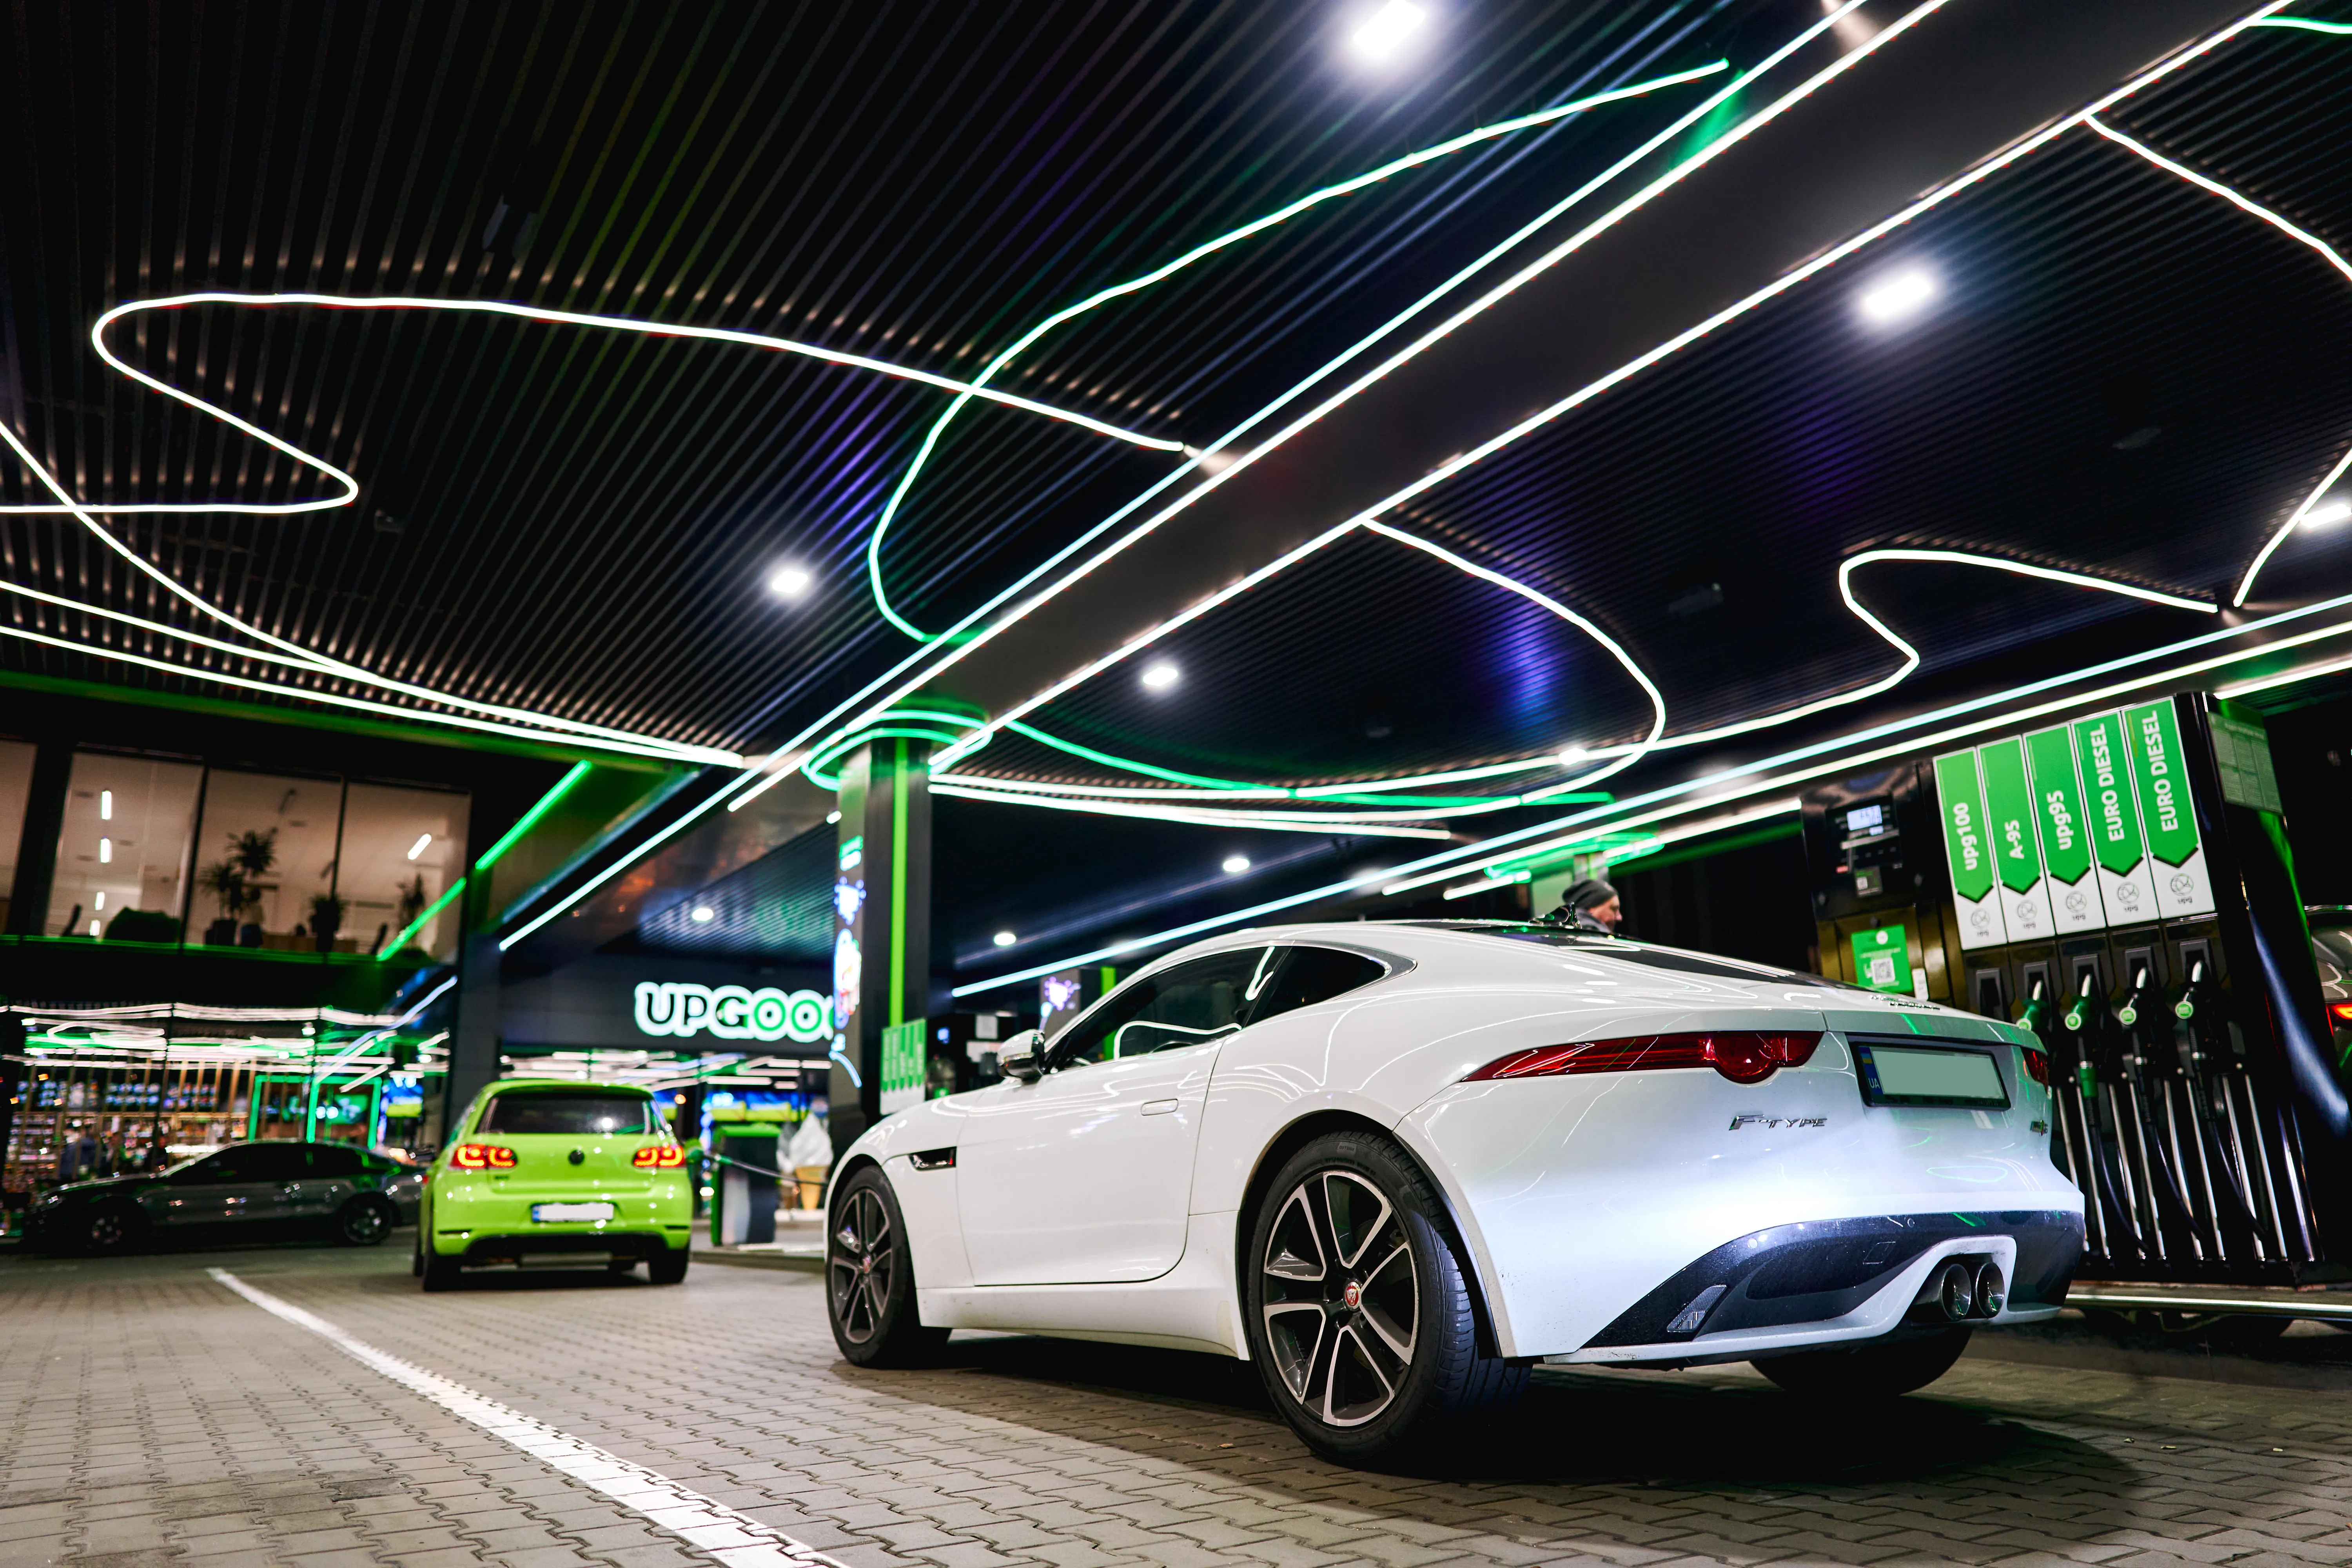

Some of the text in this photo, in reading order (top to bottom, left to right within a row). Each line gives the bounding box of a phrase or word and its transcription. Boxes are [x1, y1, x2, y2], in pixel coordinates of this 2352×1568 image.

[2090, 723, 2125, 842] EURO DIESEL
[2141, 710, 2178, 832] EURO DIESEL
[1953, 802, 1979, 871] upg100
[2004, 820, 2024, 859] A-95
[2047, 790, 2074, 850] upg95
[639, 986, 834, 1038] UPGOO
[1868, 1078, 1880, 1089] UA
[1729, 1114, 1828, 1131] F-TYPE
